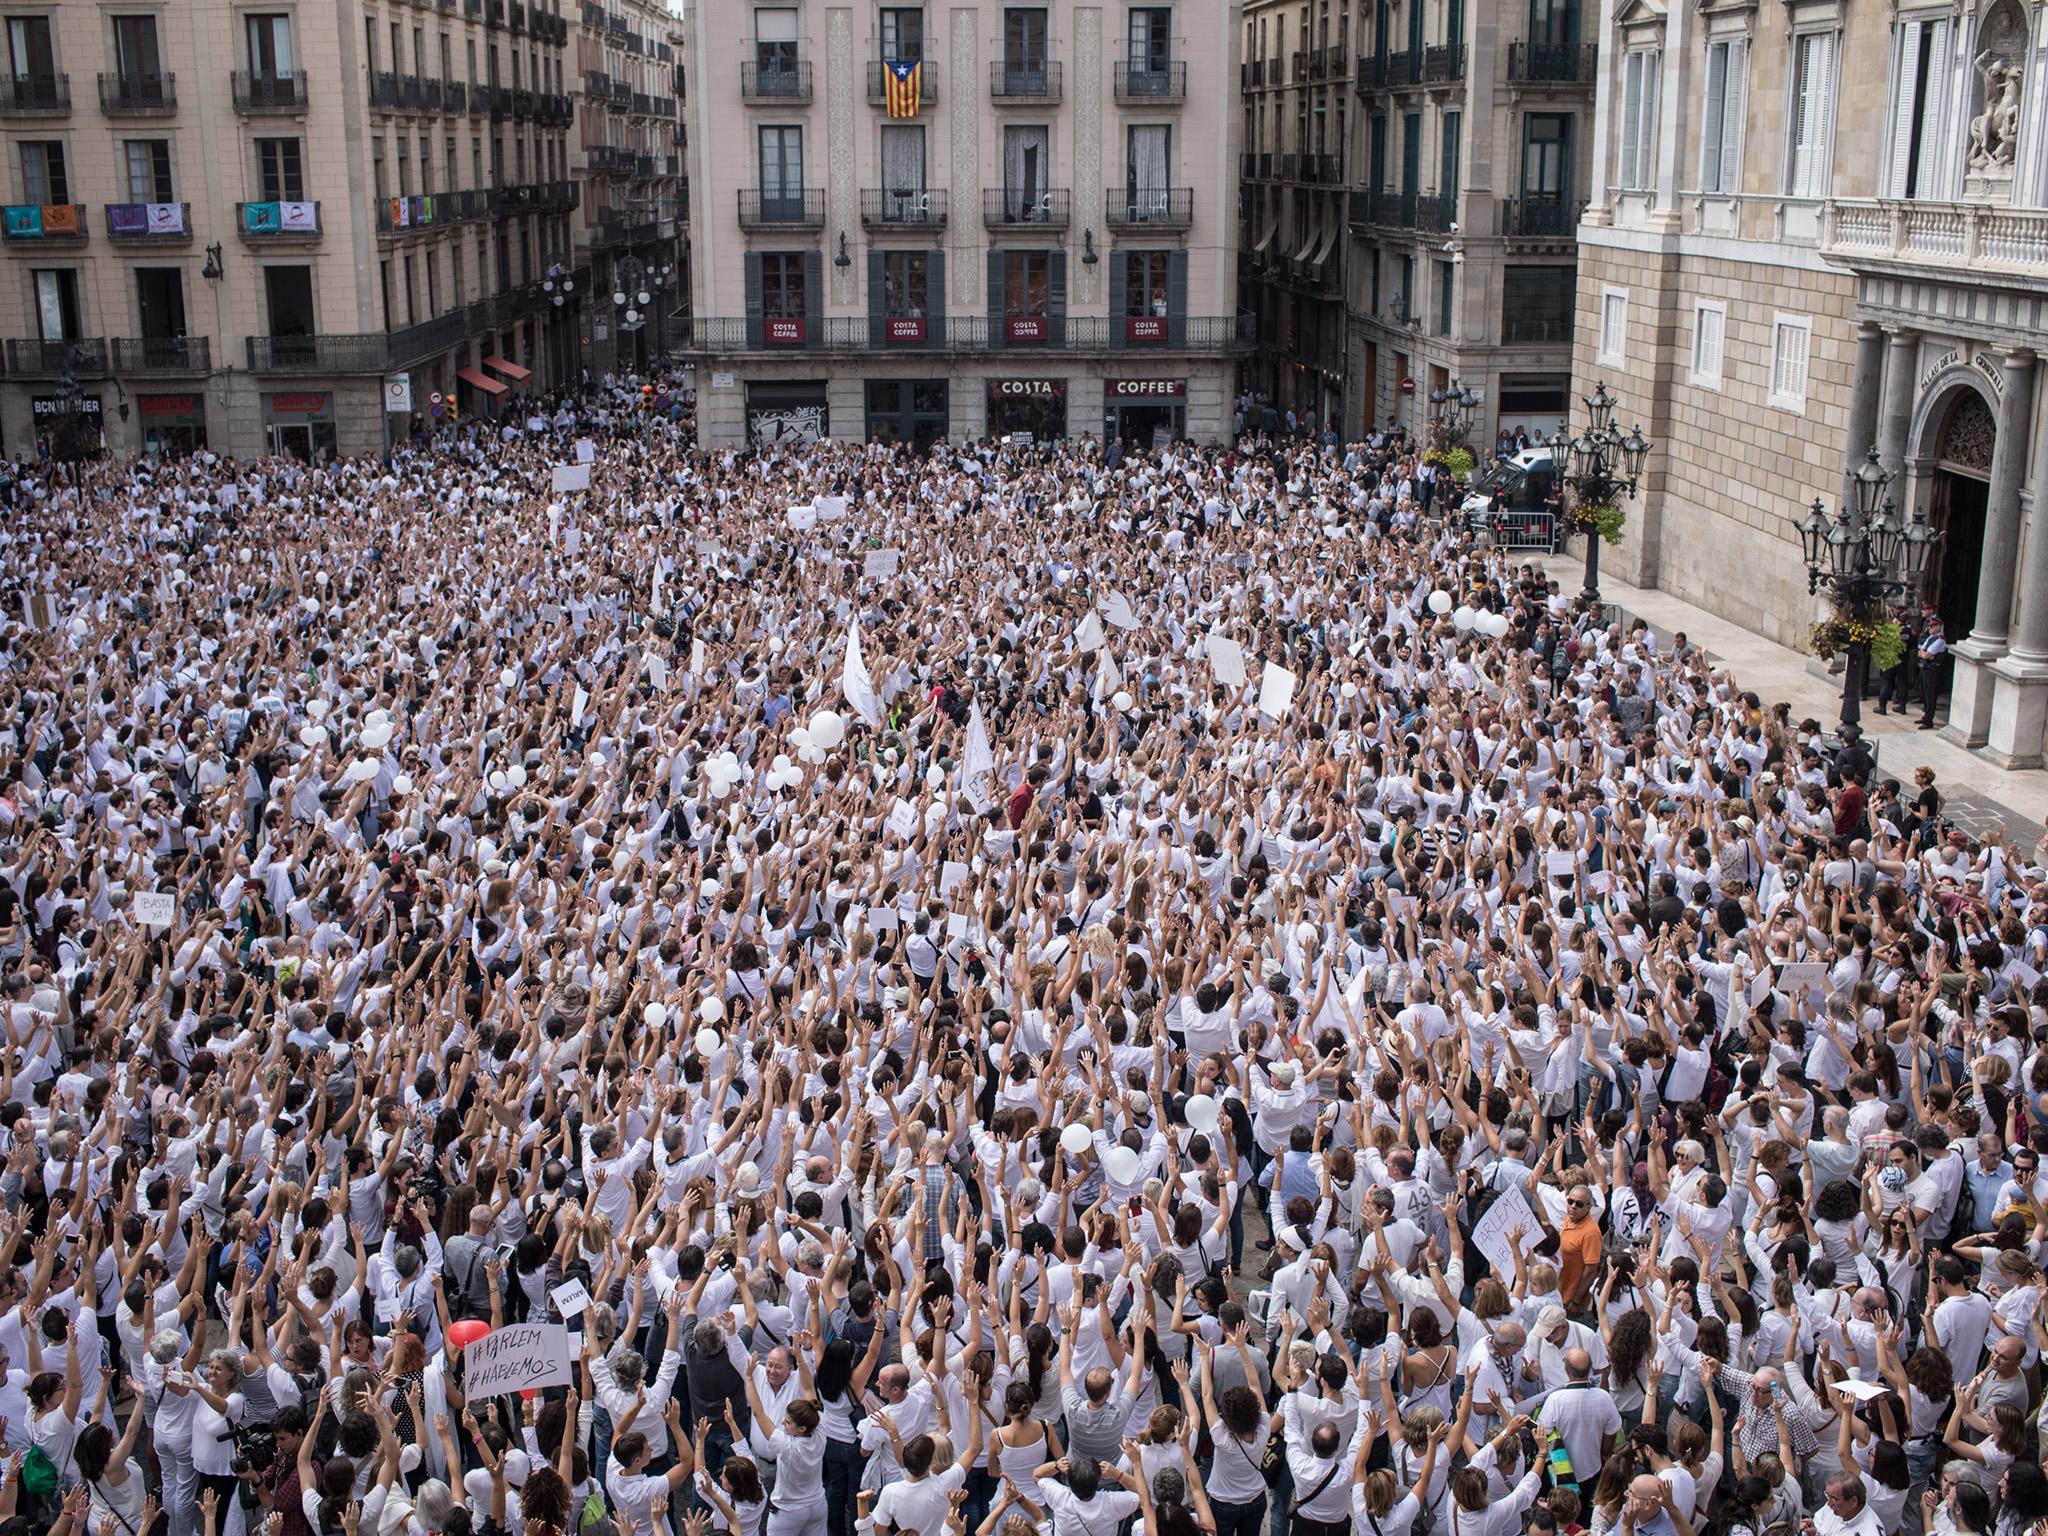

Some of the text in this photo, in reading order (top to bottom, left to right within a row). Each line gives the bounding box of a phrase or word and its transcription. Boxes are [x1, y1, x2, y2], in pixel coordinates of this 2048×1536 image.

[773, 323, 797, 331] COSTA
[893, 321, 918, 329] COSTA
[1013, 321, 1038, 329] COSTA
[1134, 321, 1159, 329] COSTA
[1920, 363, 1940, 392] PALAU
[1939, 355, 1950, 369] DE
[1949, 351, 1960, 362] LA
[1001, 381, 1052, 394] COSTA
[1117, 381, 1175, 394] COFFEE
[34, 401, 56, 413] BCN
[1407, 1186, 1431, 1211] 43
[468, 1355, 558, 1393] #HABLEMOS
